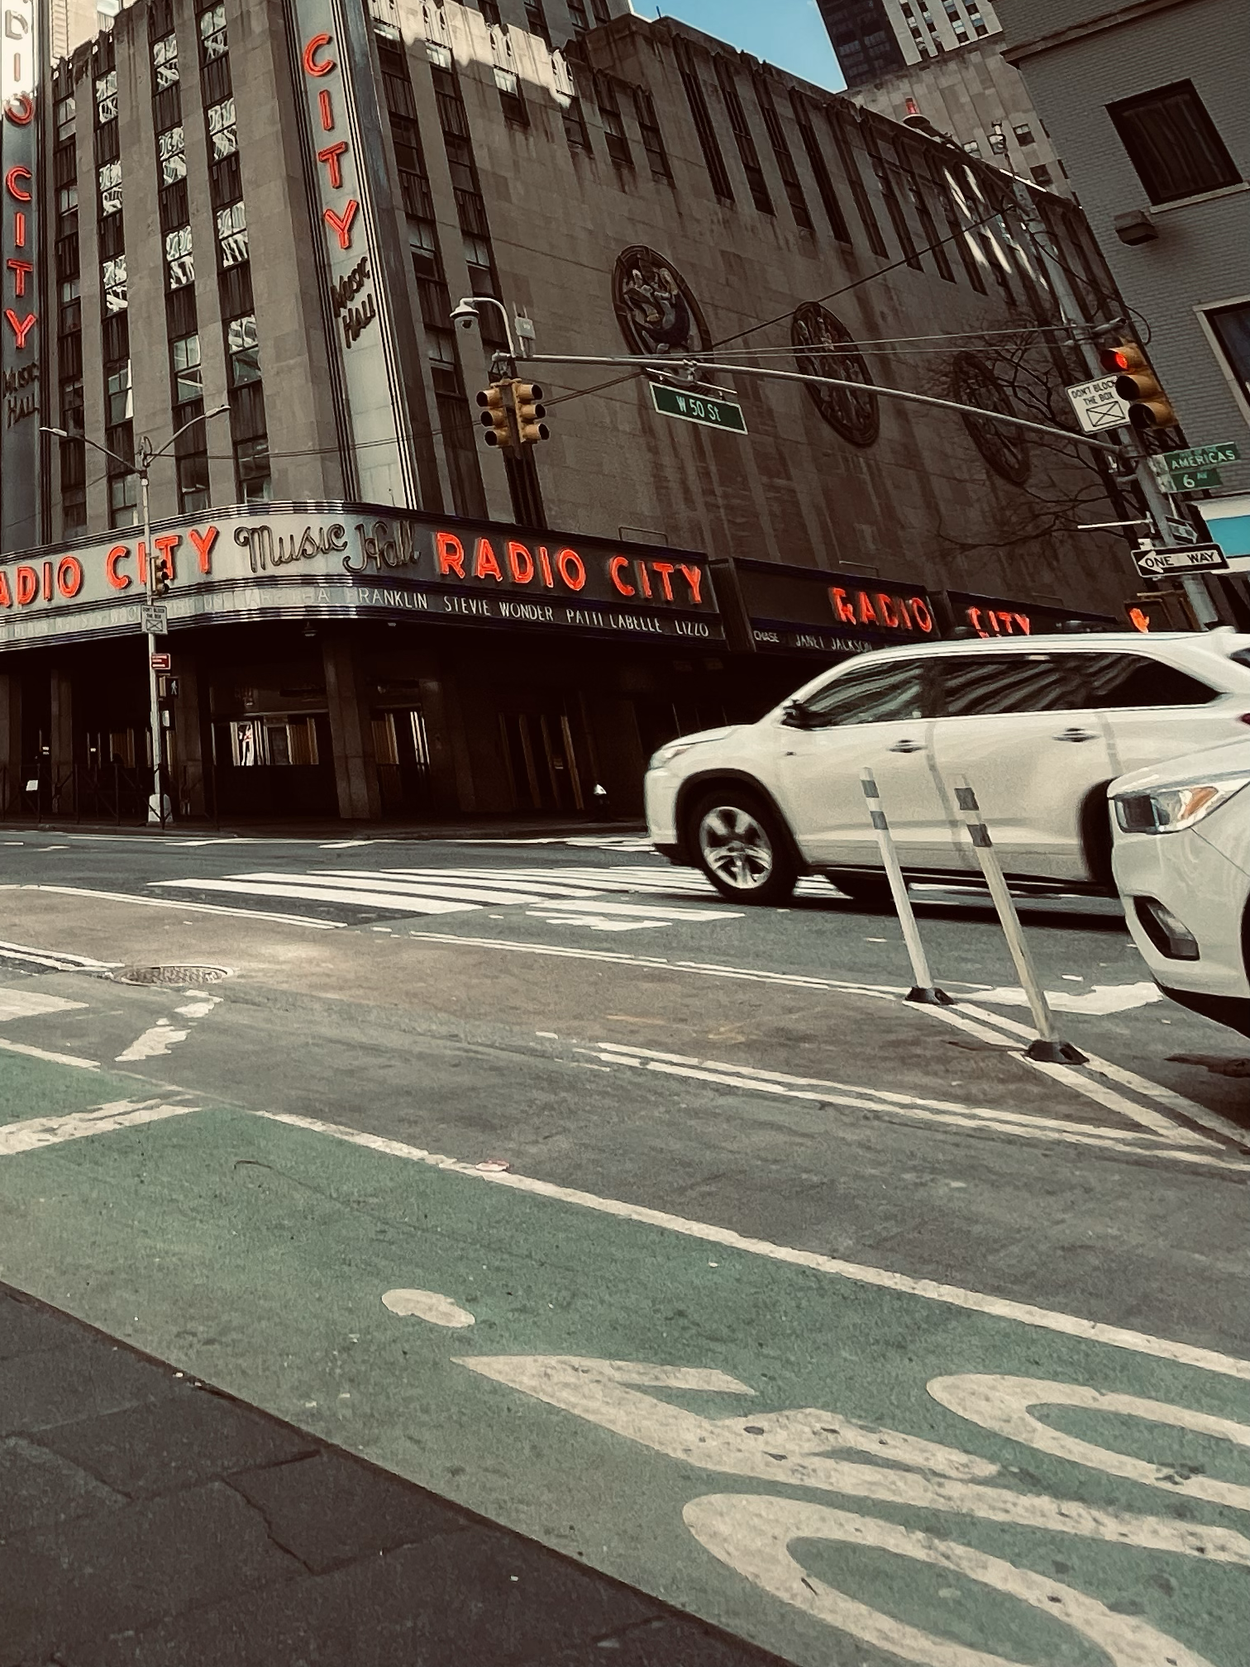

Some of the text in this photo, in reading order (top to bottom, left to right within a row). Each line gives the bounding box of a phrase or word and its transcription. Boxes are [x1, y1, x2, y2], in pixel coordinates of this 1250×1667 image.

[301, 31, 359, 250] CITY
[4, 165, 37, 349] CITY
[676, 395, 721, 422] W 50 St
[1071, 387, 1091, 400] DON'T
[1083, 391, 1115, 407] THE BOX
[1171, 450, 1236, 470] AMERICAS
[1183, 474, 1196, 489] 6
[106, 525, 220, 590] CITY
[234, 519, 421, 574] Music Hall
[434, 530, 703, 604] RADIO CITY
[1144, 551, 1216, 569] ONE WAY
[443, 597, 491, 617] STEVIE
[499, 600, 554, 622] WONDER
[566, 609, 604, 628] PATTI
[609, 612, 663, 634] LABELLE
[674, 619, 710, 638] LIZZO
[829, 585, 934, 633] RADIO
